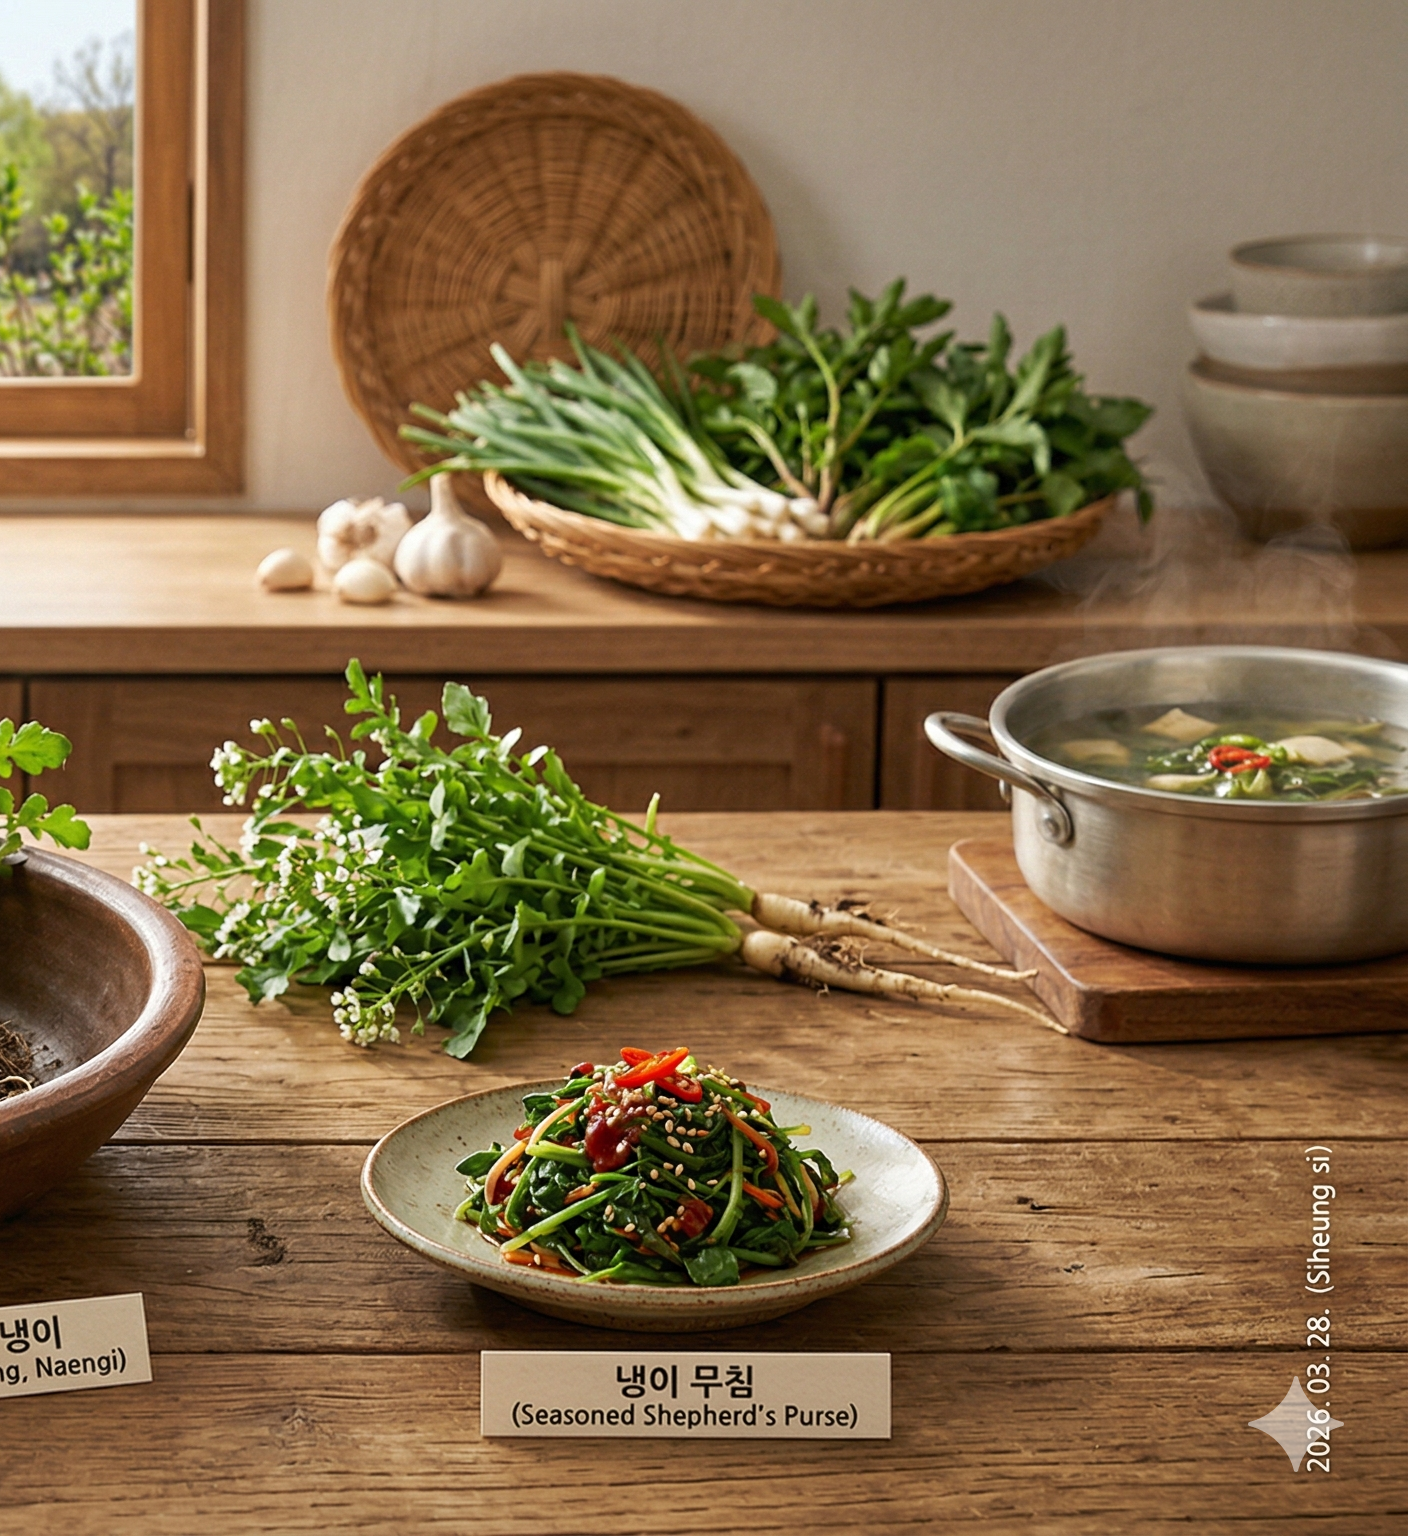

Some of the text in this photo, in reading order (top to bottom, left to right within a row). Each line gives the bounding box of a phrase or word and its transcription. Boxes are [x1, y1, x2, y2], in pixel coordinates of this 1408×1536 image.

[35, 1347, 127, 1379] Naengi)
[616, 1364, 753, 1399] 냉이 무침
[511, 1401, 859, 1430] (Seasoned Shepherd's Purse)
